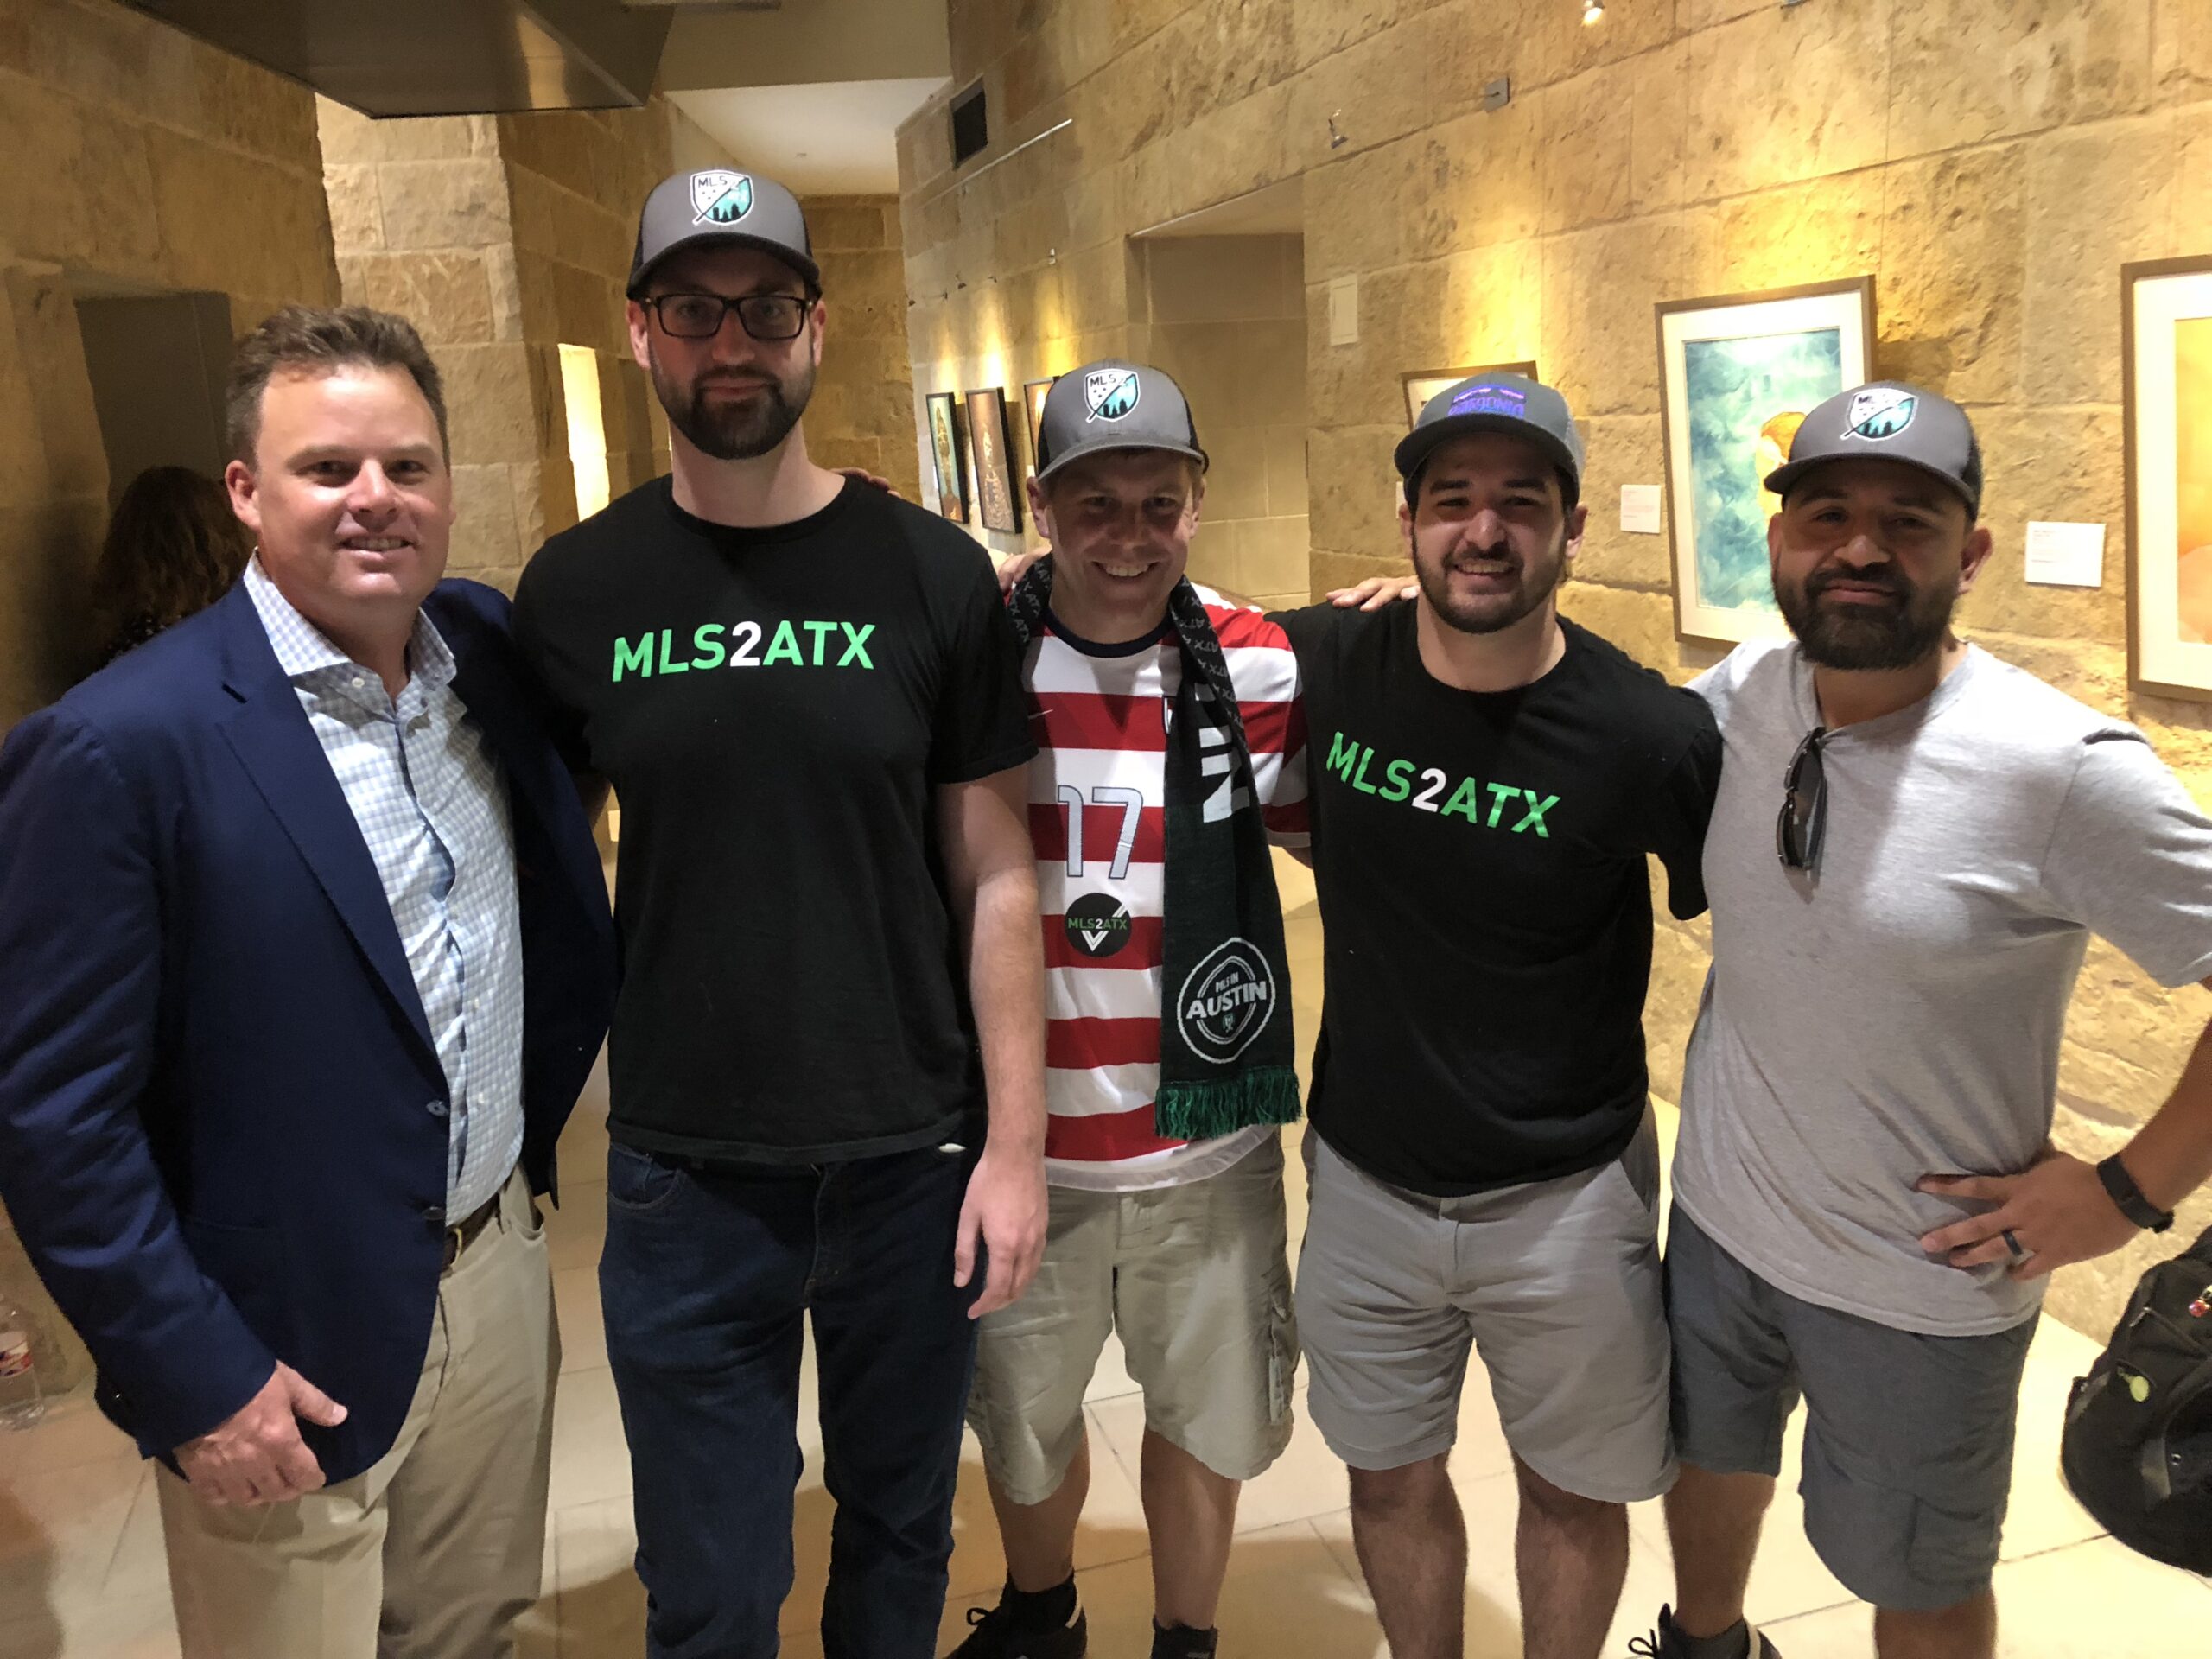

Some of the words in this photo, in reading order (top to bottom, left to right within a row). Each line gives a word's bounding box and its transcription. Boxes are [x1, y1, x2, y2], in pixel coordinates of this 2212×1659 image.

[698, 175, 728, 188] MLS
[1090, 373, 1116, 387] MLS
[612, 620, 877, 683] MLS2ATX
[1325, 731, 1561, 838] MLS2ATX
[1058, 784, 1144, 880] 17
[1068, 918, 1128, 931] MLS2ATX
[1185, 981, 1267, 1020] AUSTIN
